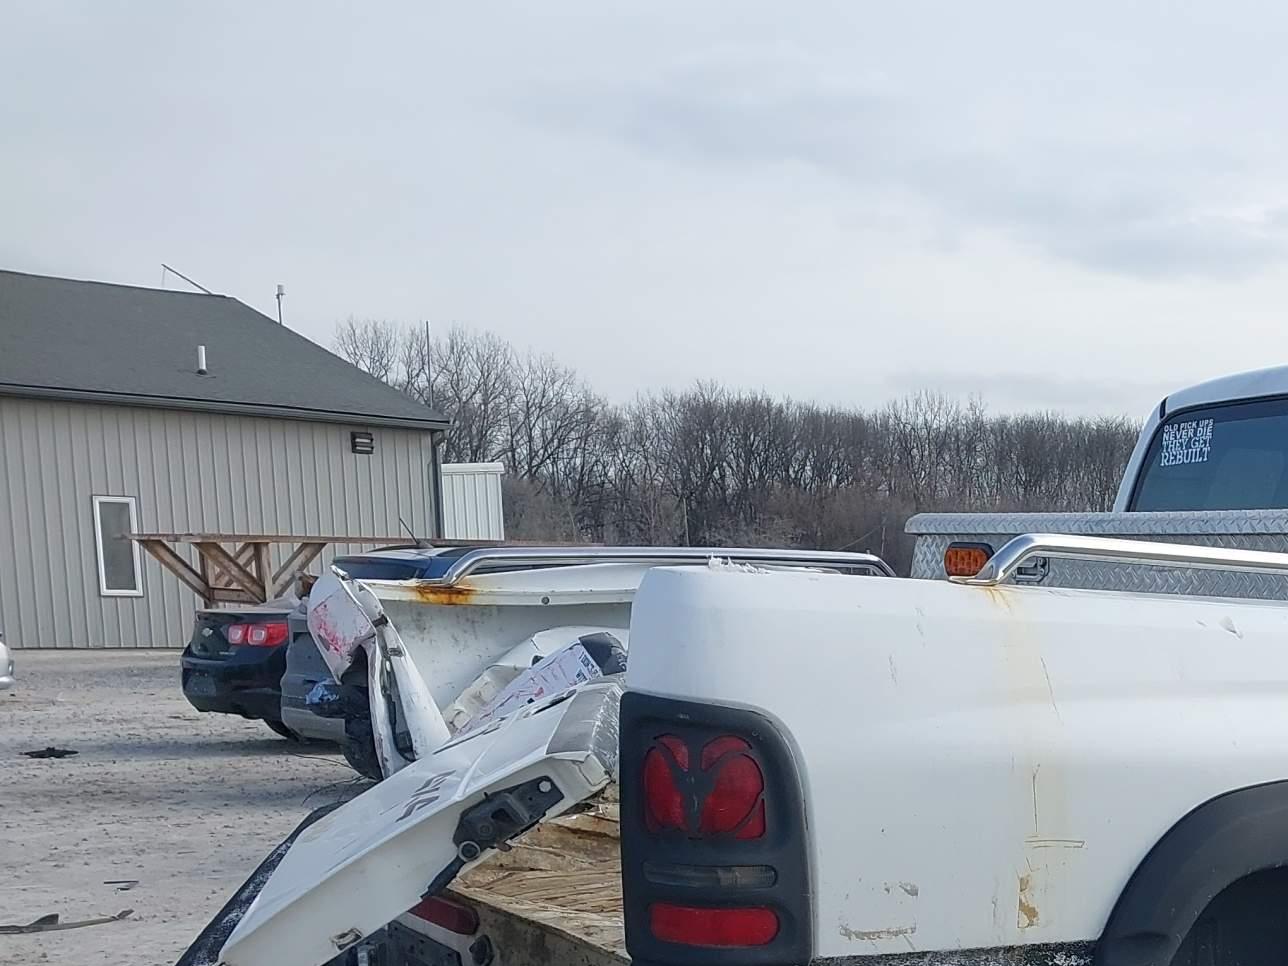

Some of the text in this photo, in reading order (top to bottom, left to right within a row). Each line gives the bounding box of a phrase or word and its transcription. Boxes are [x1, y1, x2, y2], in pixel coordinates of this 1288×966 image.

[1164, 418, 1214, 432] OLD PICK UPS
[1163, 426, 1213, 441] NEVER DIE
[1162, 435, 1211, 452] THEY GET
[1160, 446, 1210, 466] REBUILT
